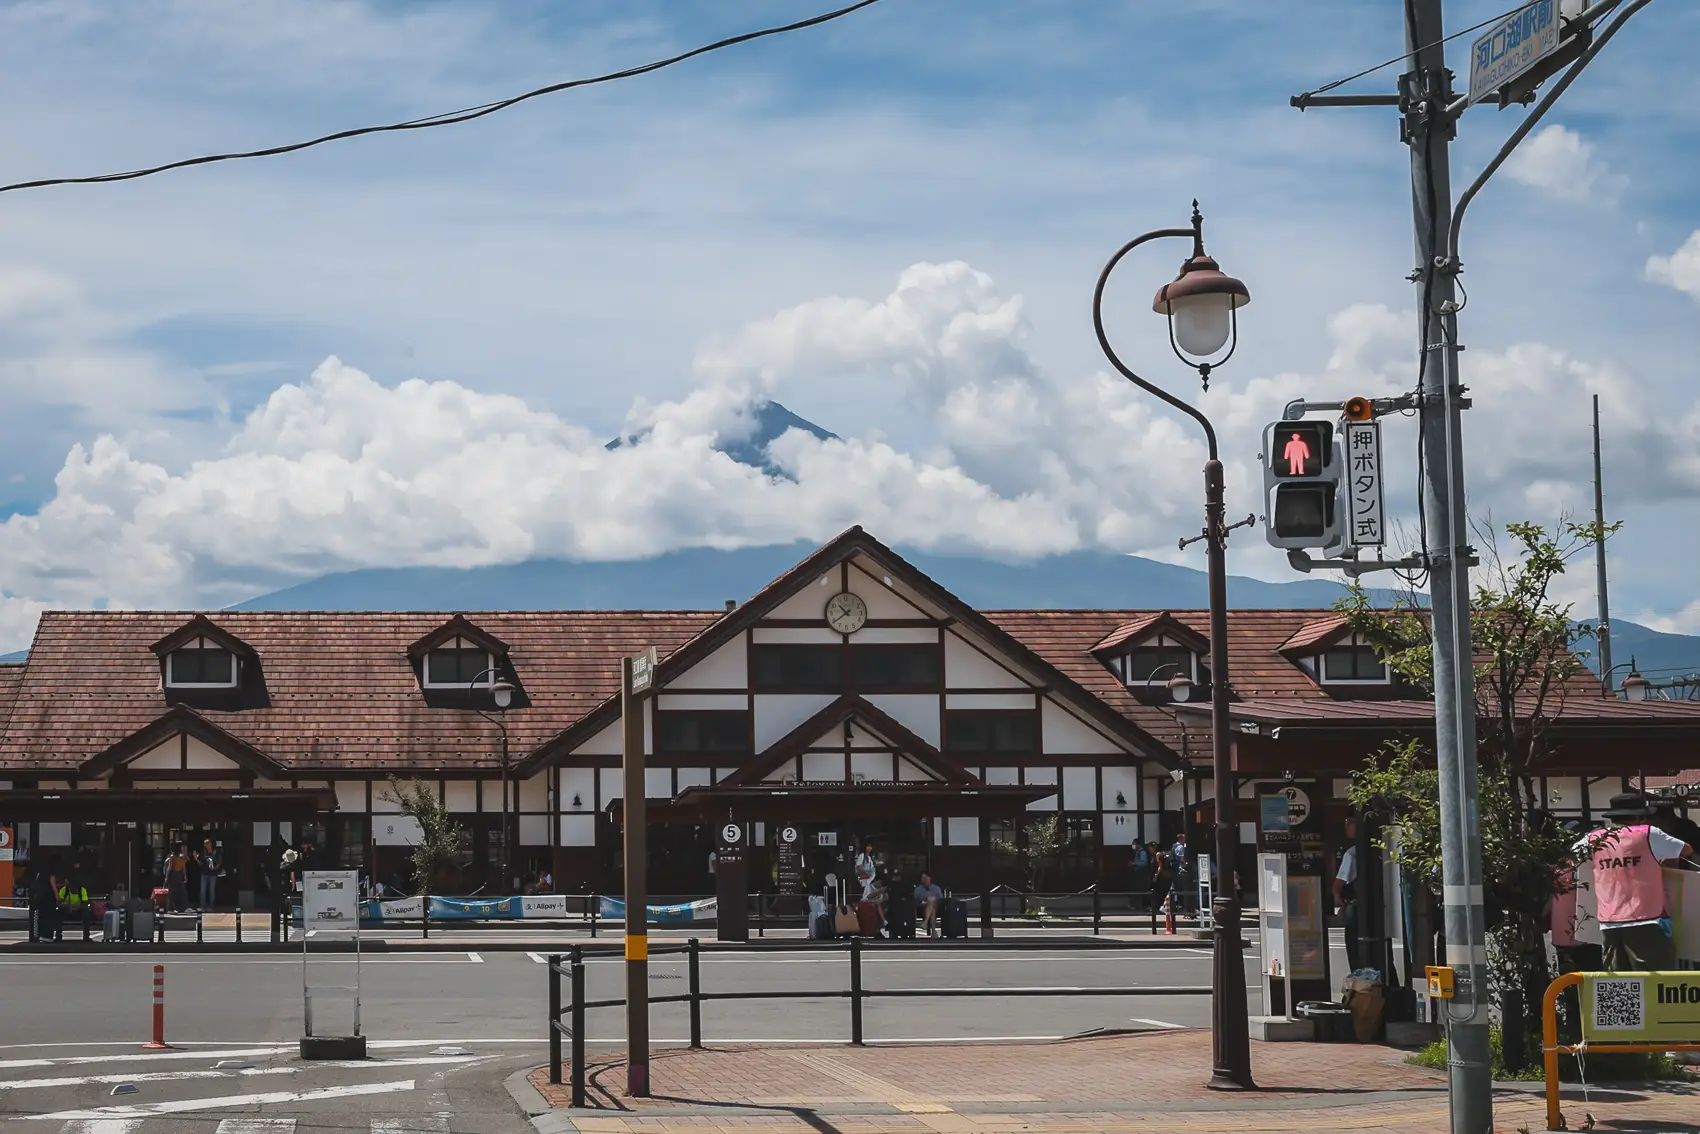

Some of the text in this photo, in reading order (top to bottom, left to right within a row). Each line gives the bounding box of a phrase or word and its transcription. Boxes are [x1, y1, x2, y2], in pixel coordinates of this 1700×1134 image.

[1476, 0, 1554, 75] 河口湖駅前
[1353, 431, 1377, 537] 押ボタン式
[1288, 790, 1294, 800] 7
[727, 826, 736, 838] 5
[786, 829, 793, 838] 2
[1598, 856, 1642, 870] STAFF
[1657, 984, 1700, 1004] Info
